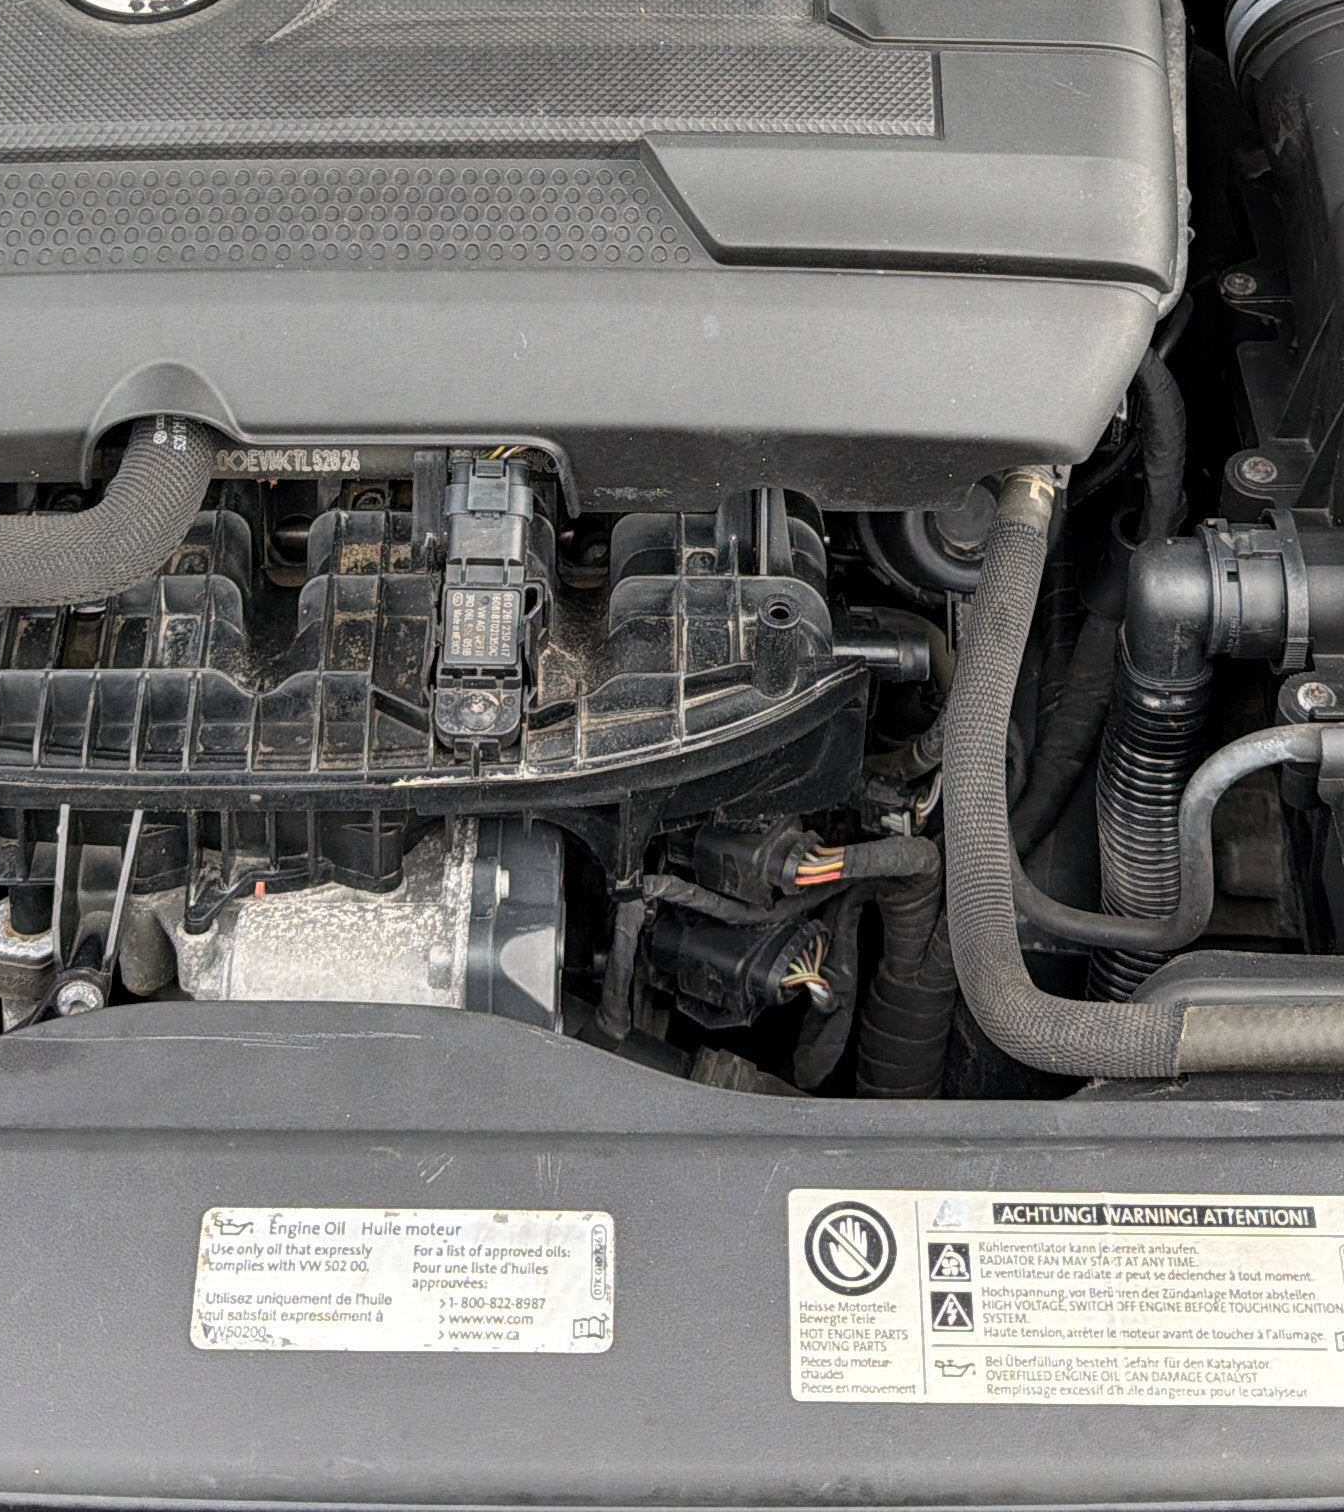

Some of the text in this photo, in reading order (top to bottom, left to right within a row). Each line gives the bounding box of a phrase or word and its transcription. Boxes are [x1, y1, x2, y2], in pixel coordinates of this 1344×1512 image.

[1000, 1205, 1309, 1226] ACHTUNG! WARNING! ATTENTION!
[269, 1220, 462, 1239] Engine Oil Huile moteur
[211, 1243, 373, 1259] Use only oil that expressly
[414, 1245, 433, 1257] For
[447, 1245, 465, 1257] list
[468, 1245, 483, 1257] of
[485, 1246, 542, 1260] approved
[546, 1246, 571, 1258] oils:
[1069, 1243, 1096, 1253] kann
[208, 1260, 264, 1274] complies
[268, 1260, 296, 1271] with
[299, 1260, 322, 1272] VW
[325, 1260, 346, 1272] 502
[979, 1255, 1164, 1267] RADIATOR FAN MAY AT ANY
[413, 1262, 549, 1275] Pour une liste d'huiles
[980, 1269, 992, 1278] Le
[994, 1269, 1055, 1279] ventilateur
[1057, 1269, 1070, 1279] de
[1126, 1271, 1151, 1282] peut
[1154, 1272, 1165, 1280] se
[1239, 1272, 1262, 1282] tout
[412, 1277, 488, 1292] approuvées:
[206, 1293, 393, 1307] Utilisez uniquement de l'huile
[1069, 1289, 1086, 1298] vor
[1142, 1288, 1159, 1299] der
[1162, 1288, 1226, 1304] Zündanlage
[1229, 1289, 1263, 1299] Motor
[799, 1301, 897, 1313] Heisse Motorteile
[982, 1301, 1012, 1310] HIGH
[1069, 1301, 1113, 1311] SWITCH
[1139, 1302, 1182, 1313] ENGINE
[1184, 1302, 1226, 1312] BEFORE
[1230, 1303, 1290, 1313] TOUCHING
[1292, 1304, 1344, 1313] IGNITION
[204, 1310, 223, 1323] qui
[281, 1310, 372, 1324] expressément
[375, 1310, 383, 1323] à
[449, 1314, 533, 1325] www.vw.com
[799, 1313, 876, 1327] Bewegte Teile
[983, 1313, 1030, 1323] SYSTEM.
[448, 1330, 520, 1340] www.vw.ca
[799, 1328, 908, 1340] HOT ENGINE PARTS
[984, 1327, 1018, 1337] Haute
[1107, 1328, 1117, 1338] le
[1163, 1330, 1193, 1339] avant
[1196, 1330, 1211, 1339] de
[1212, 1330, 1254, 1340] toucher
[800, 1341, 887, 1352] MOVING PARTS
[834, 1357, 848, 1367] du
[1076, 1357, 1118, 1368] besteht
[1164, 1357, 1181, 1368] für
[1183, 1358, 1204, 1368] den
[986, 1370, 1052, 1381] OVERFILLED
[1055, 1371, 1098, 1381] ENGINE
[1152, 1372, 1202, 1382] DAMAGE
[1205, 1372, 1258, 1383] CATALYST
[836, 1385, 849, 1393] en
[852, 1385, 916, 1394] mouvement
[987, 1384, 1057, 1398] Remplissage
[1060, 1385, 1104, 1395] excessif
[1147, 1388, 1207, 1399] dangereux
[1211, 1388, 1236, 1399] pour
[1239, 1387, 1249, 1396] le
